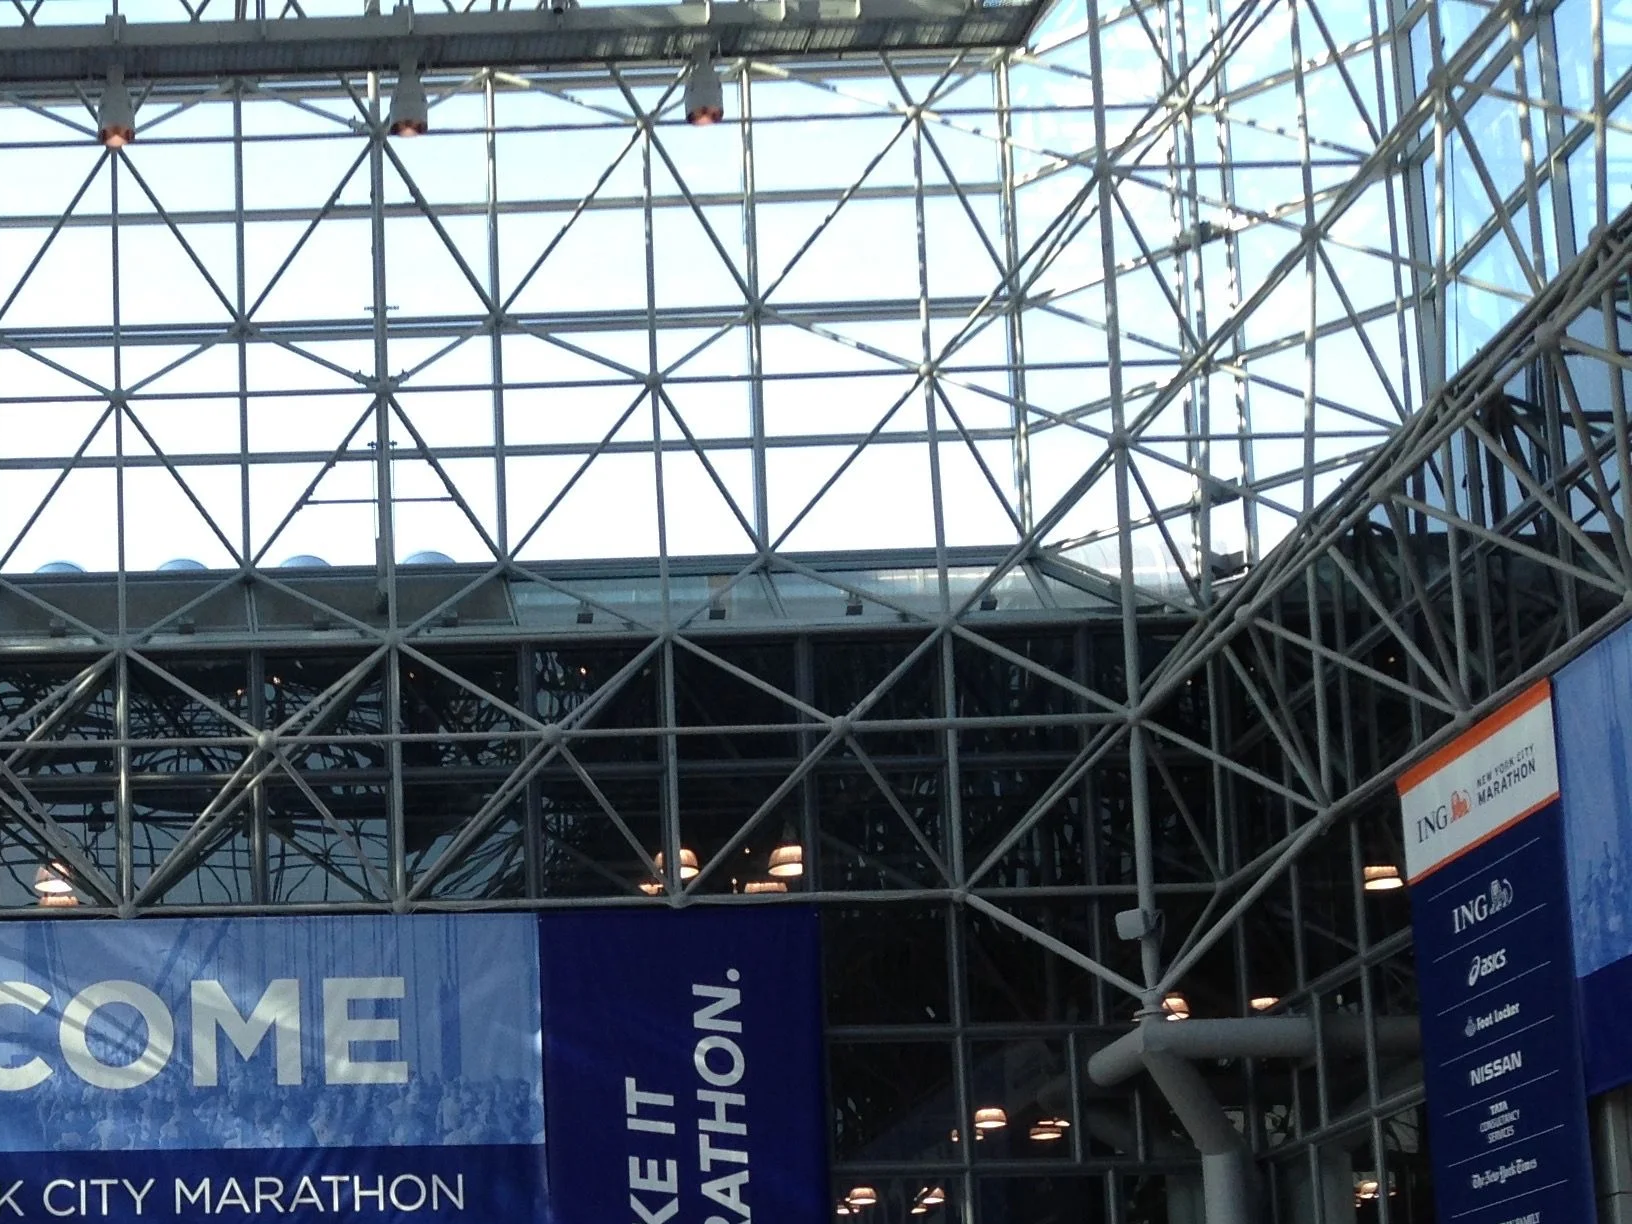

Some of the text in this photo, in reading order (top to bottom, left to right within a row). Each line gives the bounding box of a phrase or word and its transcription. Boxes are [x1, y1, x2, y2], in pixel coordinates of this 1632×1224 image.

[1477, 744, 1535, 787] NEW YORK CITY
[1478, 758, 1536, 805] MARATHON
[1417, 805, 1448, 843] ING
[1452, 894, 1488, 934] ING
[1470, 1050, 1522, 1086] NISSAN
[625, 1077, 675, 1135] IT
[43, 1177, 156, 1217] CITY
[175, 1173, 465, 1215] MARATHON
